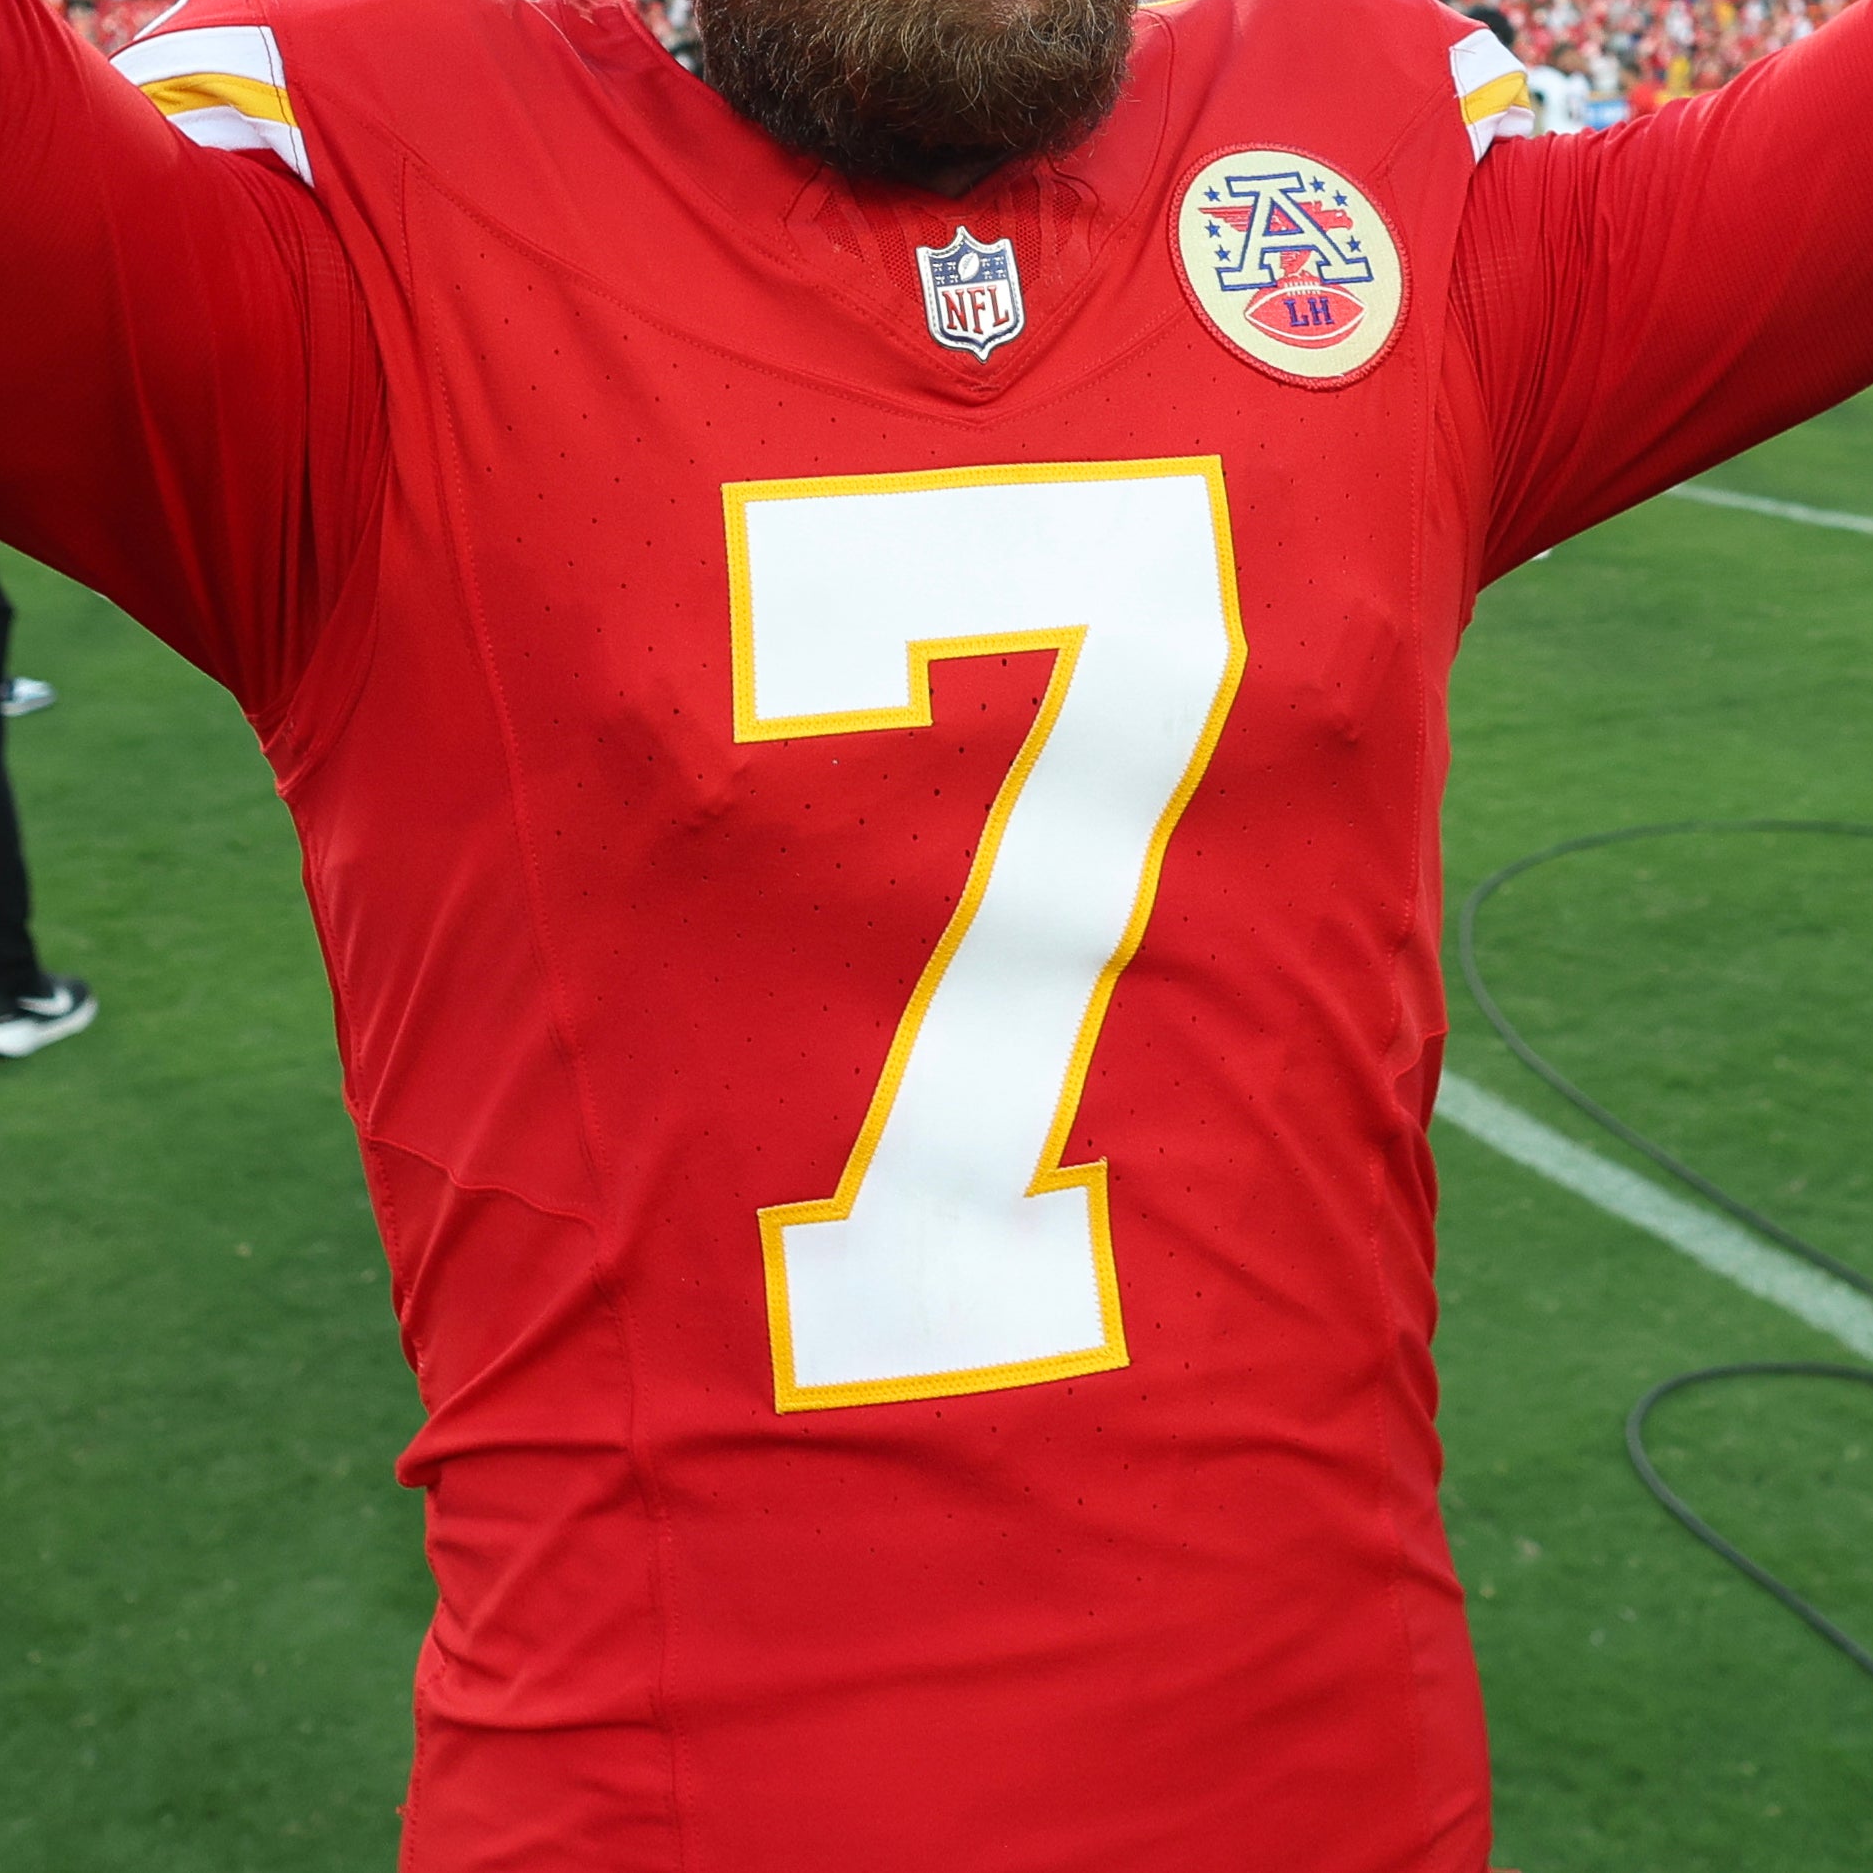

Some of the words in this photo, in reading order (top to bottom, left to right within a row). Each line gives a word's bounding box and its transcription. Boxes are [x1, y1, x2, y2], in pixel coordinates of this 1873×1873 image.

[1215, 172, 1374, 291] A
[941, 285, 1009, 334] NFL
[1283, 297, 1335, 327] LH
[721, 456, 1248, 1414] 7
